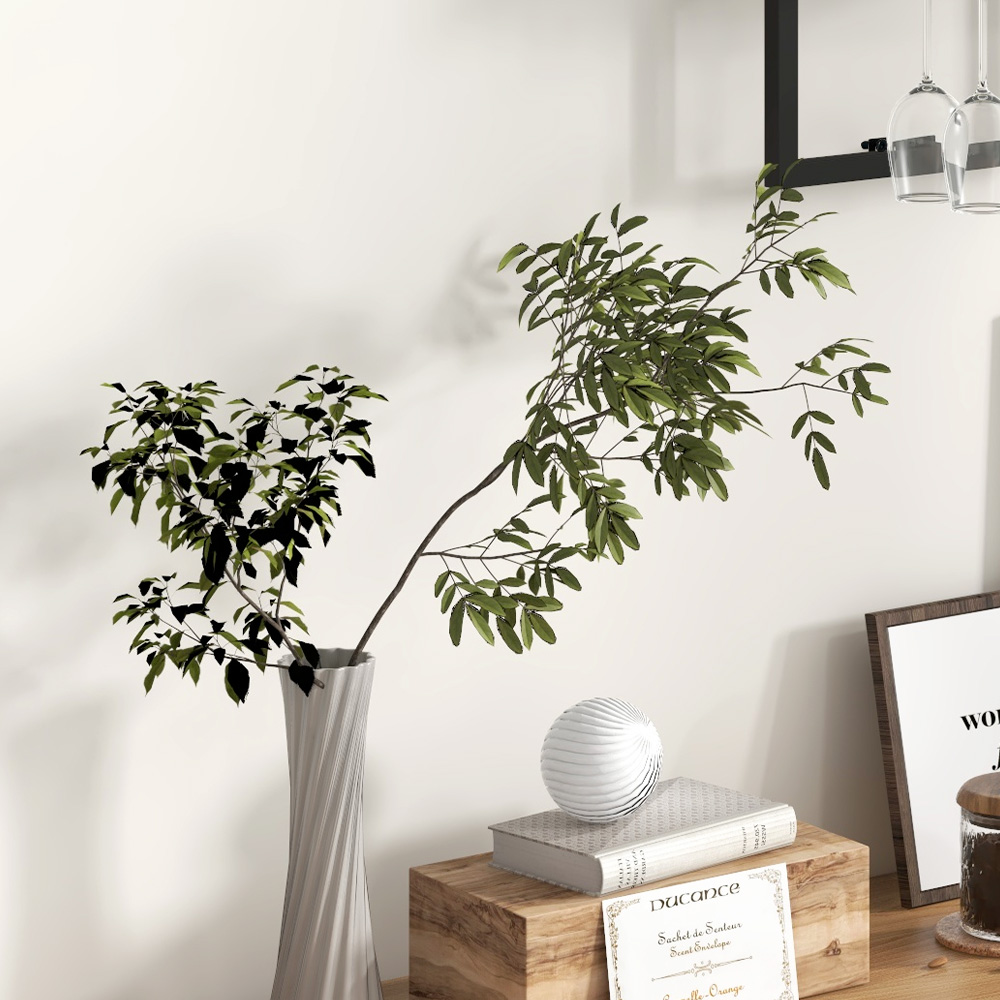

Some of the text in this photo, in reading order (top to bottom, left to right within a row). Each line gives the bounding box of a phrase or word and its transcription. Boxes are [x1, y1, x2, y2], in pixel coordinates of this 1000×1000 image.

[657, 921, 742, 946] Sachet de Senteur
[669, 938, 731, 958] Scent Envelope
